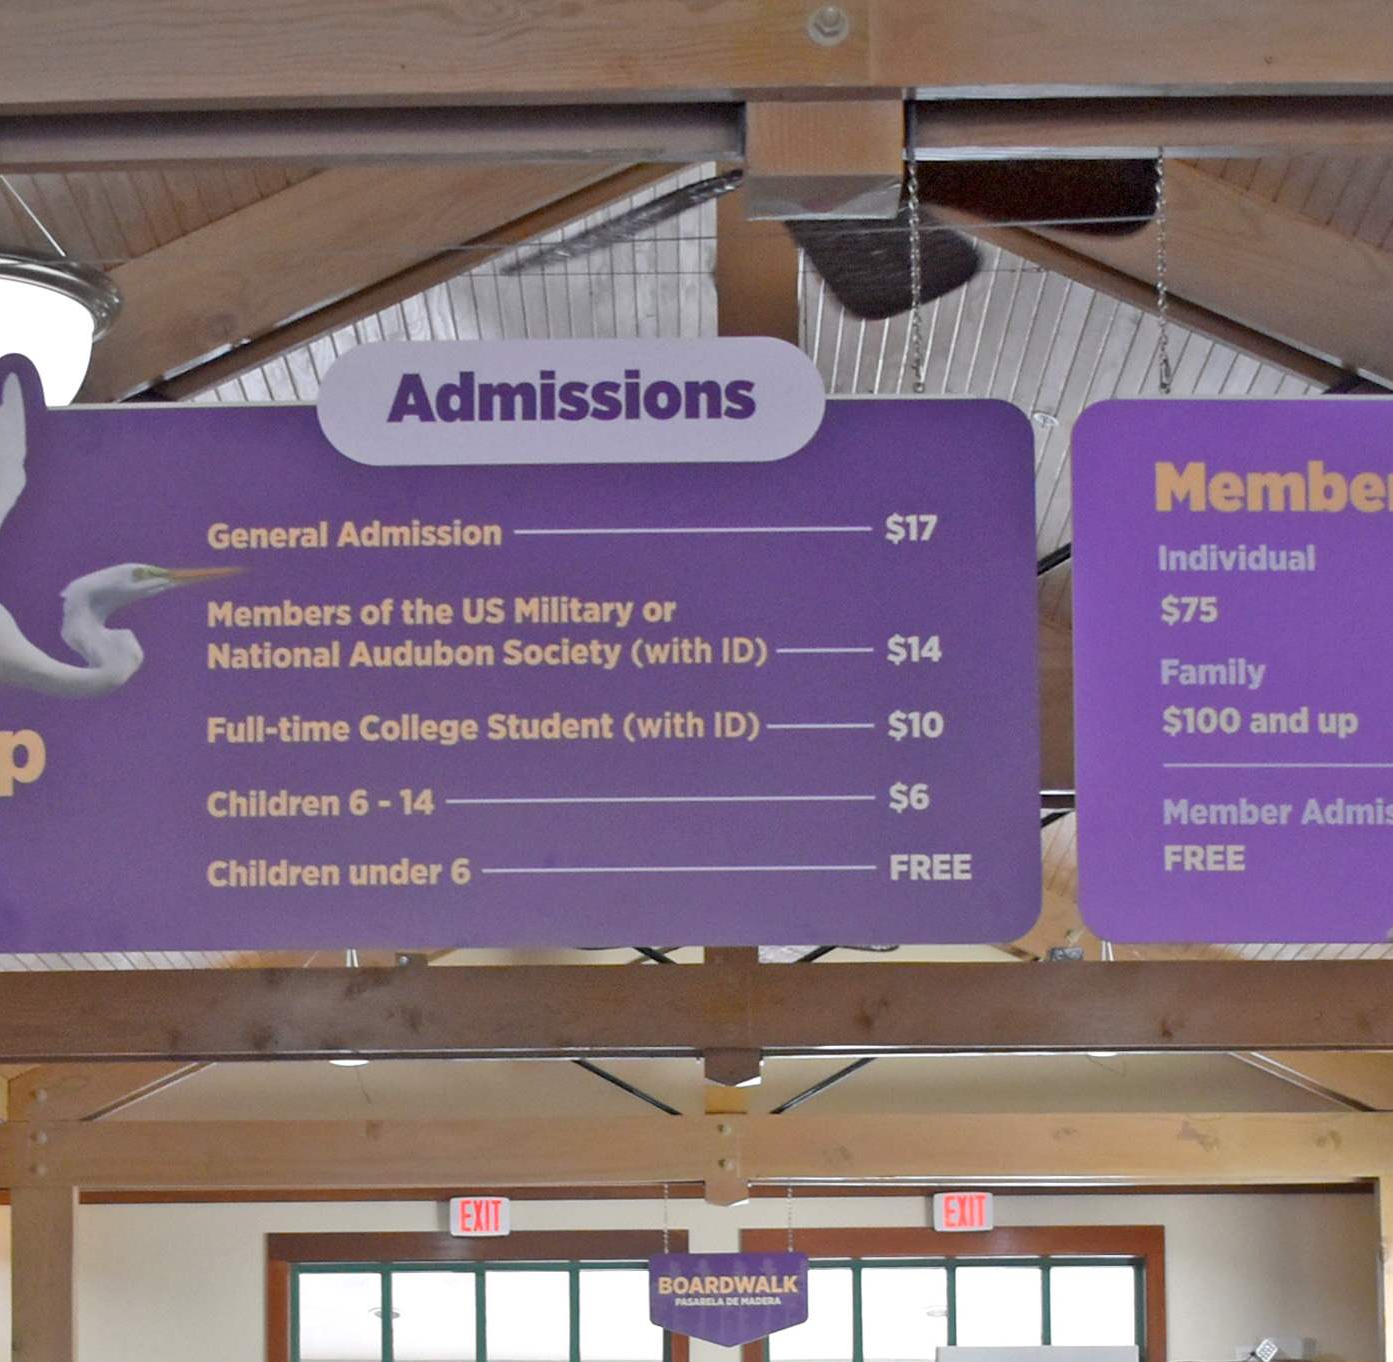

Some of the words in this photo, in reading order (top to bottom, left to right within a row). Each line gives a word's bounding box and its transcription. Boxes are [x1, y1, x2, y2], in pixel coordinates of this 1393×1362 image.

[387, 369, 756, 424] Admissions
[208, 522, 329, 549] General
[338, 519, 502, 548] Admission
[885, 513, 937, 545] $17
[1158, 545, 1316, 571] Individual
[208, 600, 352, 628] Members
[360, 600, 394, 626] of
[401, 600, 454, 626] the
[462, 598, 505, 625] US
[514, 596, 635, 629] Military
[644, 602, 676, 623] or
[1161, 595, 1218, 624] $75
[208, 640, 341, 670] National
[349, 640, 495, 668] Audubon
[503, 638, 622, 671] Society
[631, 636, 712, 669] (with
[722, 636, 768, 668] ID)
[887, 635, 942, 666] $14
[1161, 659, 1265, 689] Family
[208, 715, 350, 744] Full-time
[360, 715, 479, 747] College
[487, 713, 613, 742] Student
[623, 711, 705, 743] (with
[713, 711, 760, 742] ID)
[888, 710, 944, 740] $10
[1163, 706, 1241, 737] $100
[1250, 708, 1308, 734] and
[1318, 711, 1358, 739] up
[208, 789, 340, 818] Children
[349, 789, 369, 816] 6
[399, 789, 435, 815] 14
[889, 782, 929, 813] $6
[1163, 799, 1291, 825] Member
[208, 859, 340, 887] Children
[349, 859, 442, 886] under
[450, 859, 471, 885] 6
[890, 855, 972, 881] FREE
[1164, 845, 1245, 871] FREE
[460, 1199, 502, 1232] EXIT
[944, 1195, 986, 1227] EXIT
[658, 1275, 798, 1294] BOARDWALK
[675, 1297, 723, 1306] PASARELA
[726, 1297, 739, 1305] DE
[741, 1297, 782, 1305] MADERA
